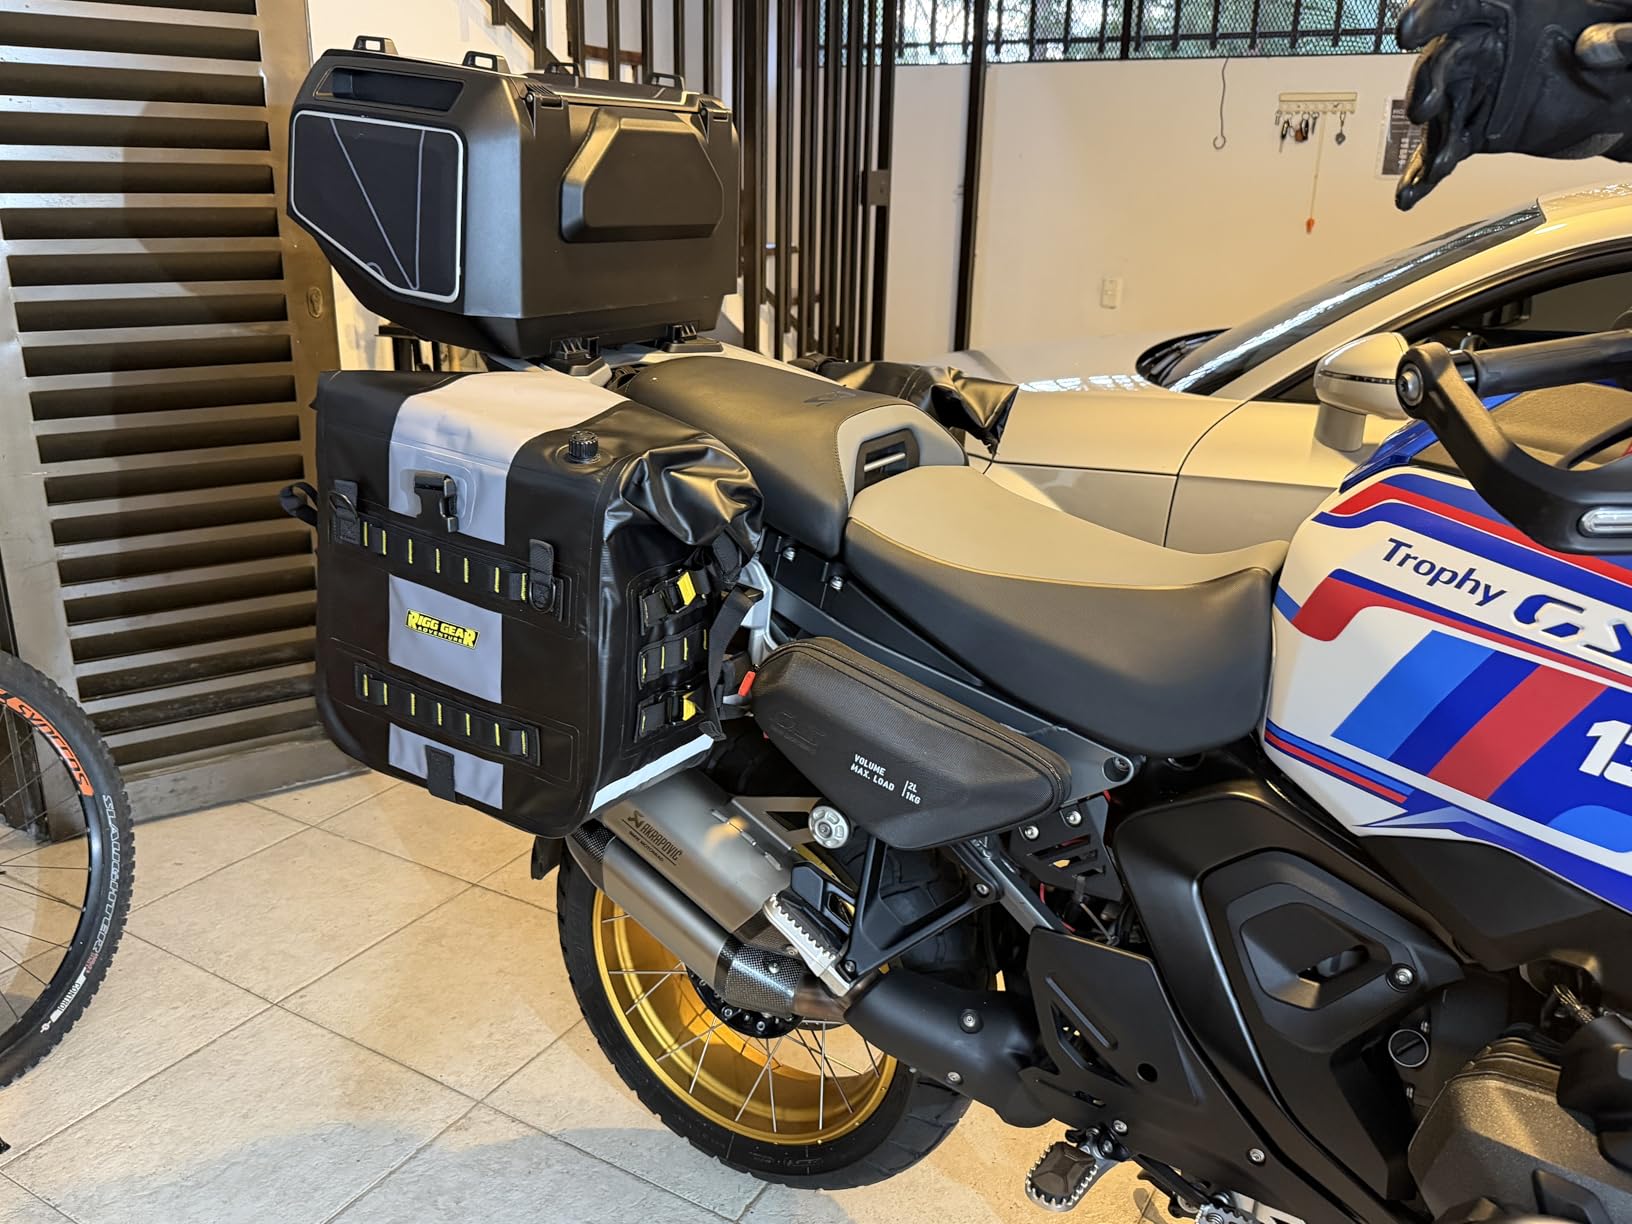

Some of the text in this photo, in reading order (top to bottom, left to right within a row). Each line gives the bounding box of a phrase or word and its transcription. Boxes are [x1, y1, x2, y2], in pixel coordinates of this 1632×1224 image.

[1382, 537, 1507, 607] Trophy
[408, 611, 476, 648] RIGG GEAR
[417, 626, 463, 644] ADVENTURE
[850, 762, 921, 805] MAX. LOAD 1KG
[854, 753, 918, 793] VOLUME 2L
[93, 794, 121, 954] SLAUGHTER
